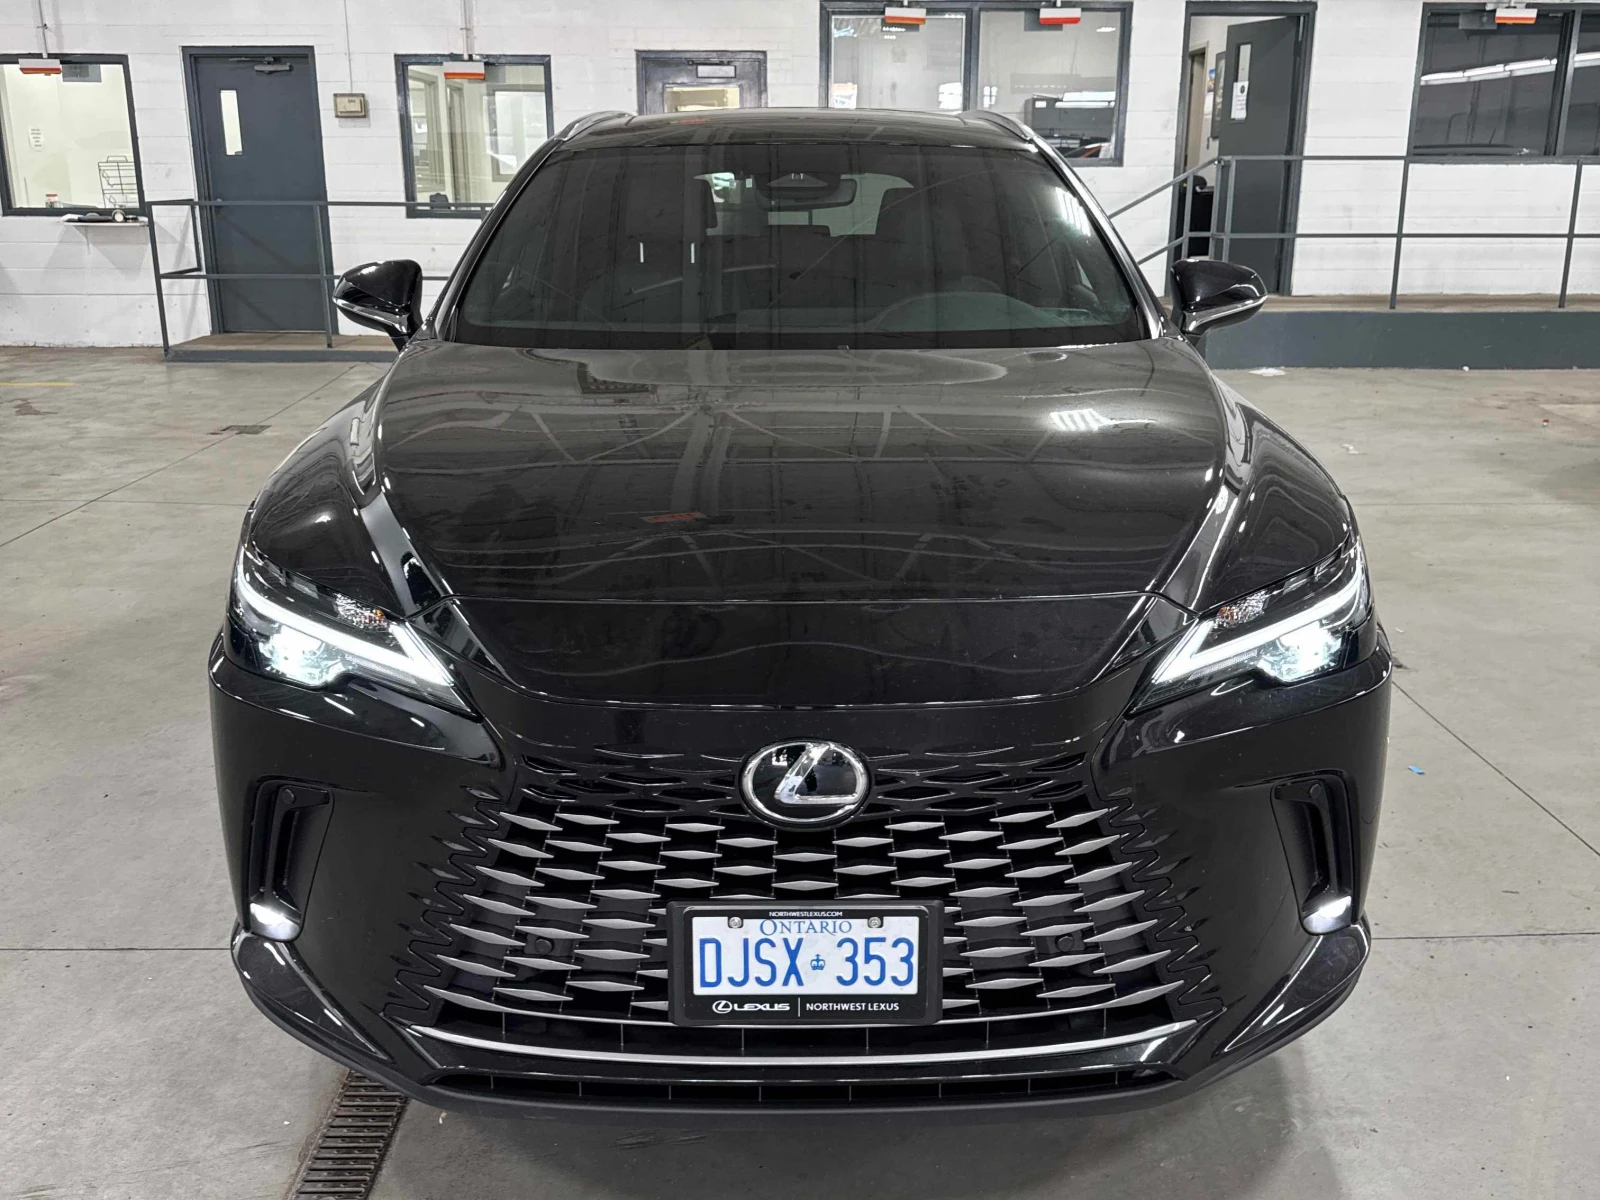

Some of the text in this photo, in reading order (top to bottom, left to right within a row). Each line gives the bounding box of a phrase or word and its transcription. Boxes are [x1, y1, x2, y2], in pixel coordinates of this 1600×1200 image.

[699, 937, 914, 988] DJSX 353
[733, 1003, 791, 1011] LEXUS
[806, 1002, 900, 1011] NORTHWEST LEXUS
